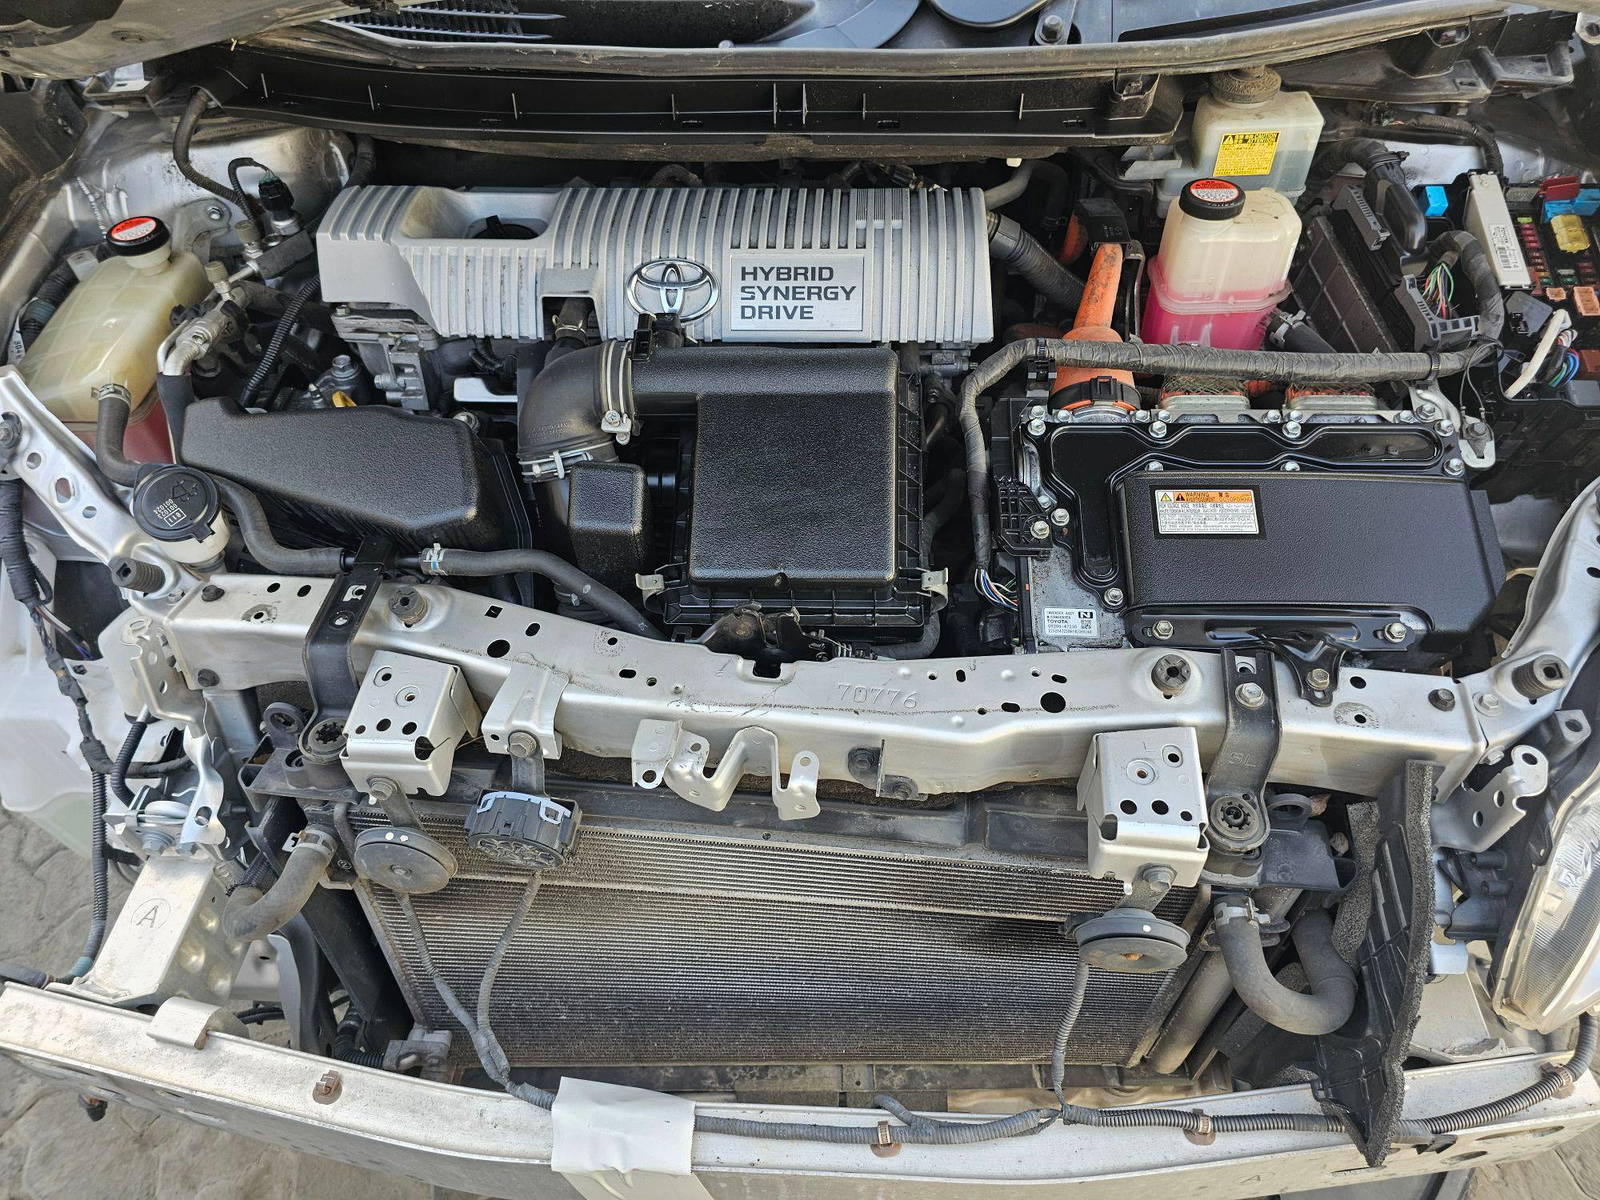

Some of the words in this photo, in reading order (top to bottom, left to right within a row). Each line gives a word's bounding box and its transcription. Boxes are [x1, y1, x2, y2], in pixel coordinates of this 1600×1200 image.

[741, 266, 834, 281] HYBRID
[740, 286, 857, 301] SYNERGY
[740, 305, 814, 320] DRIVE
[837, 681, 919, 709] 70776
[136, 904, 159, 928] A
